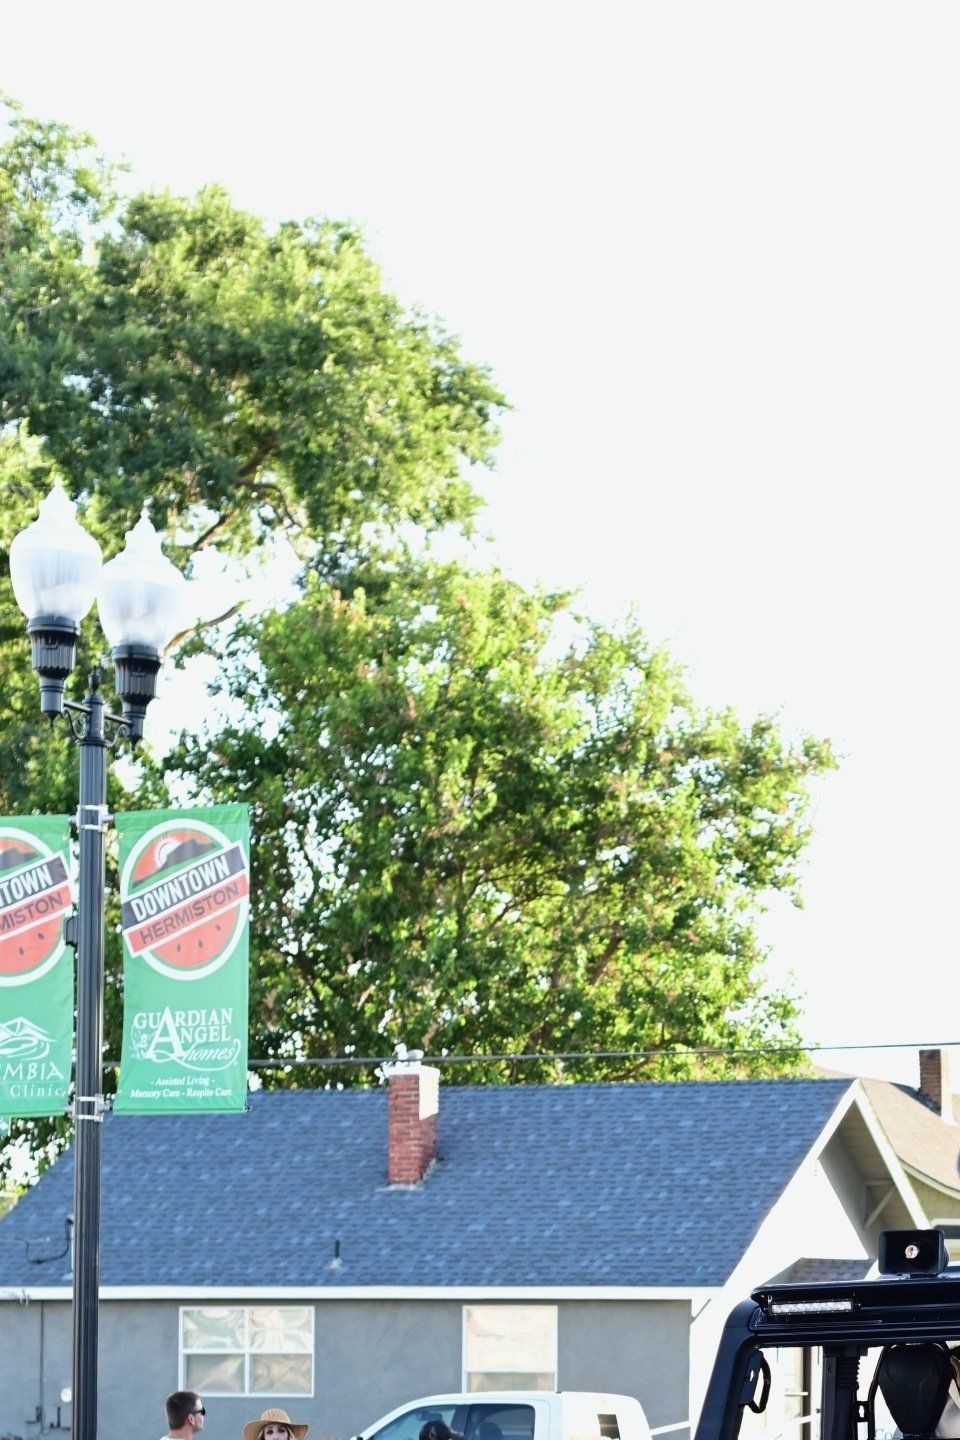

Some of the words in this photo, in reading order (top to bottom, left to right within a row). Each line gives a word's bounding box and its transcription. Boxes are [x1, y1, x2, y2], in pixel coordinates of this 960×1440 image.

[131, 854, 231, 922] DOWNTOWN
[140, 881, 239, 945] HERMISTON
[133, 1006, 234, 1042] GUARDIAN
[130, 1088, 161, 1100] Memory
[163, 1087, 180, 1098] Care
[186, 1087, 214, 1100] Respite
[215, 1087, 232, 1097] Care
[155, 1076, 185, 1086] Assisted
[186, 1075, 210, 1088] Living
